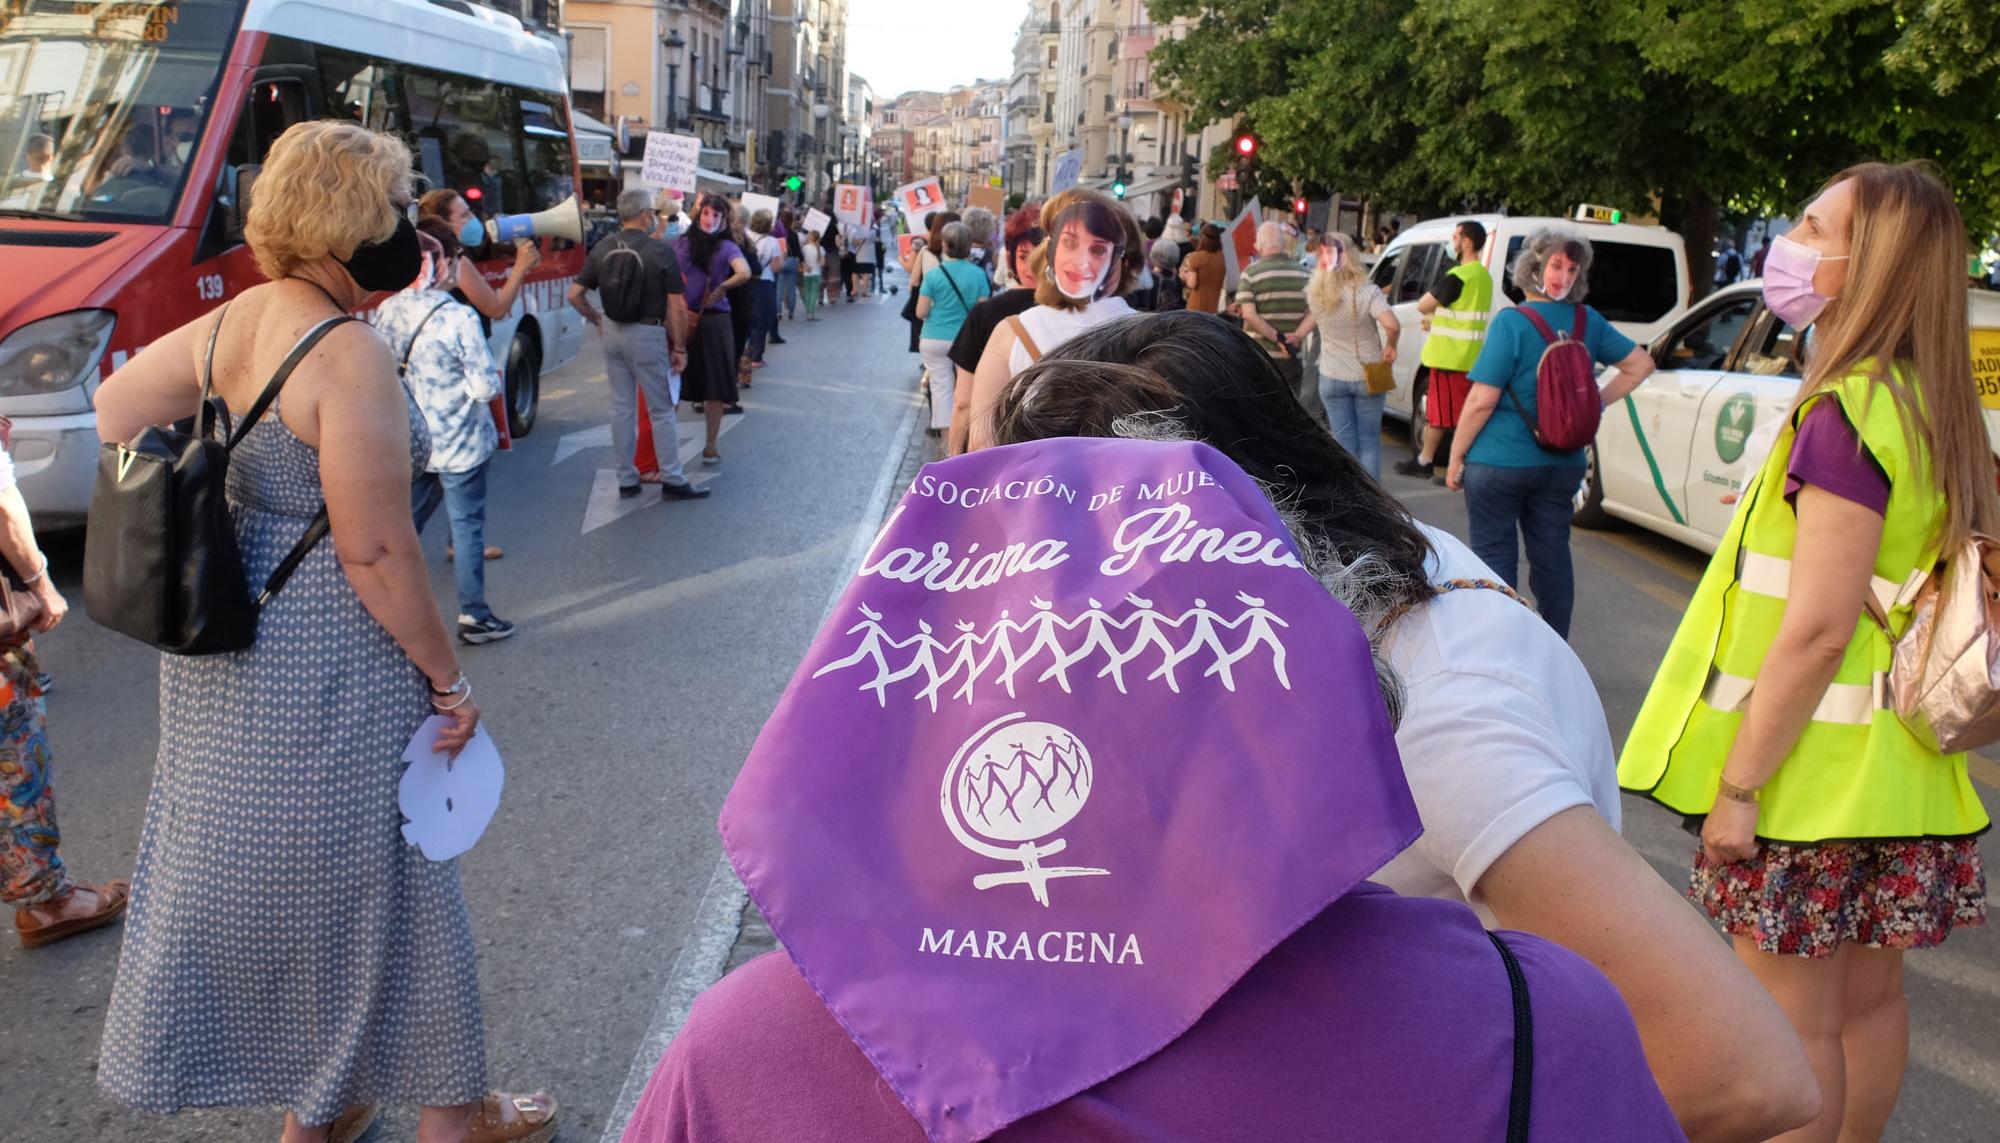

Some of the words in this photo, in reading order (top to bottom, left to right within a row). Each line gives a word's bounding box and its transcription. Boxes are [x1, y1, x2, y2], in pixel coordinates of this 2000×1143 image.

[196, 274, 224, 300] 139
[1975, 376, 2000, 396] 95
[1088, 484, 1124, 512] DE
[1137, 470, 1224, 500] MUJE
[918, 927, 1144, 965] MARACENA
